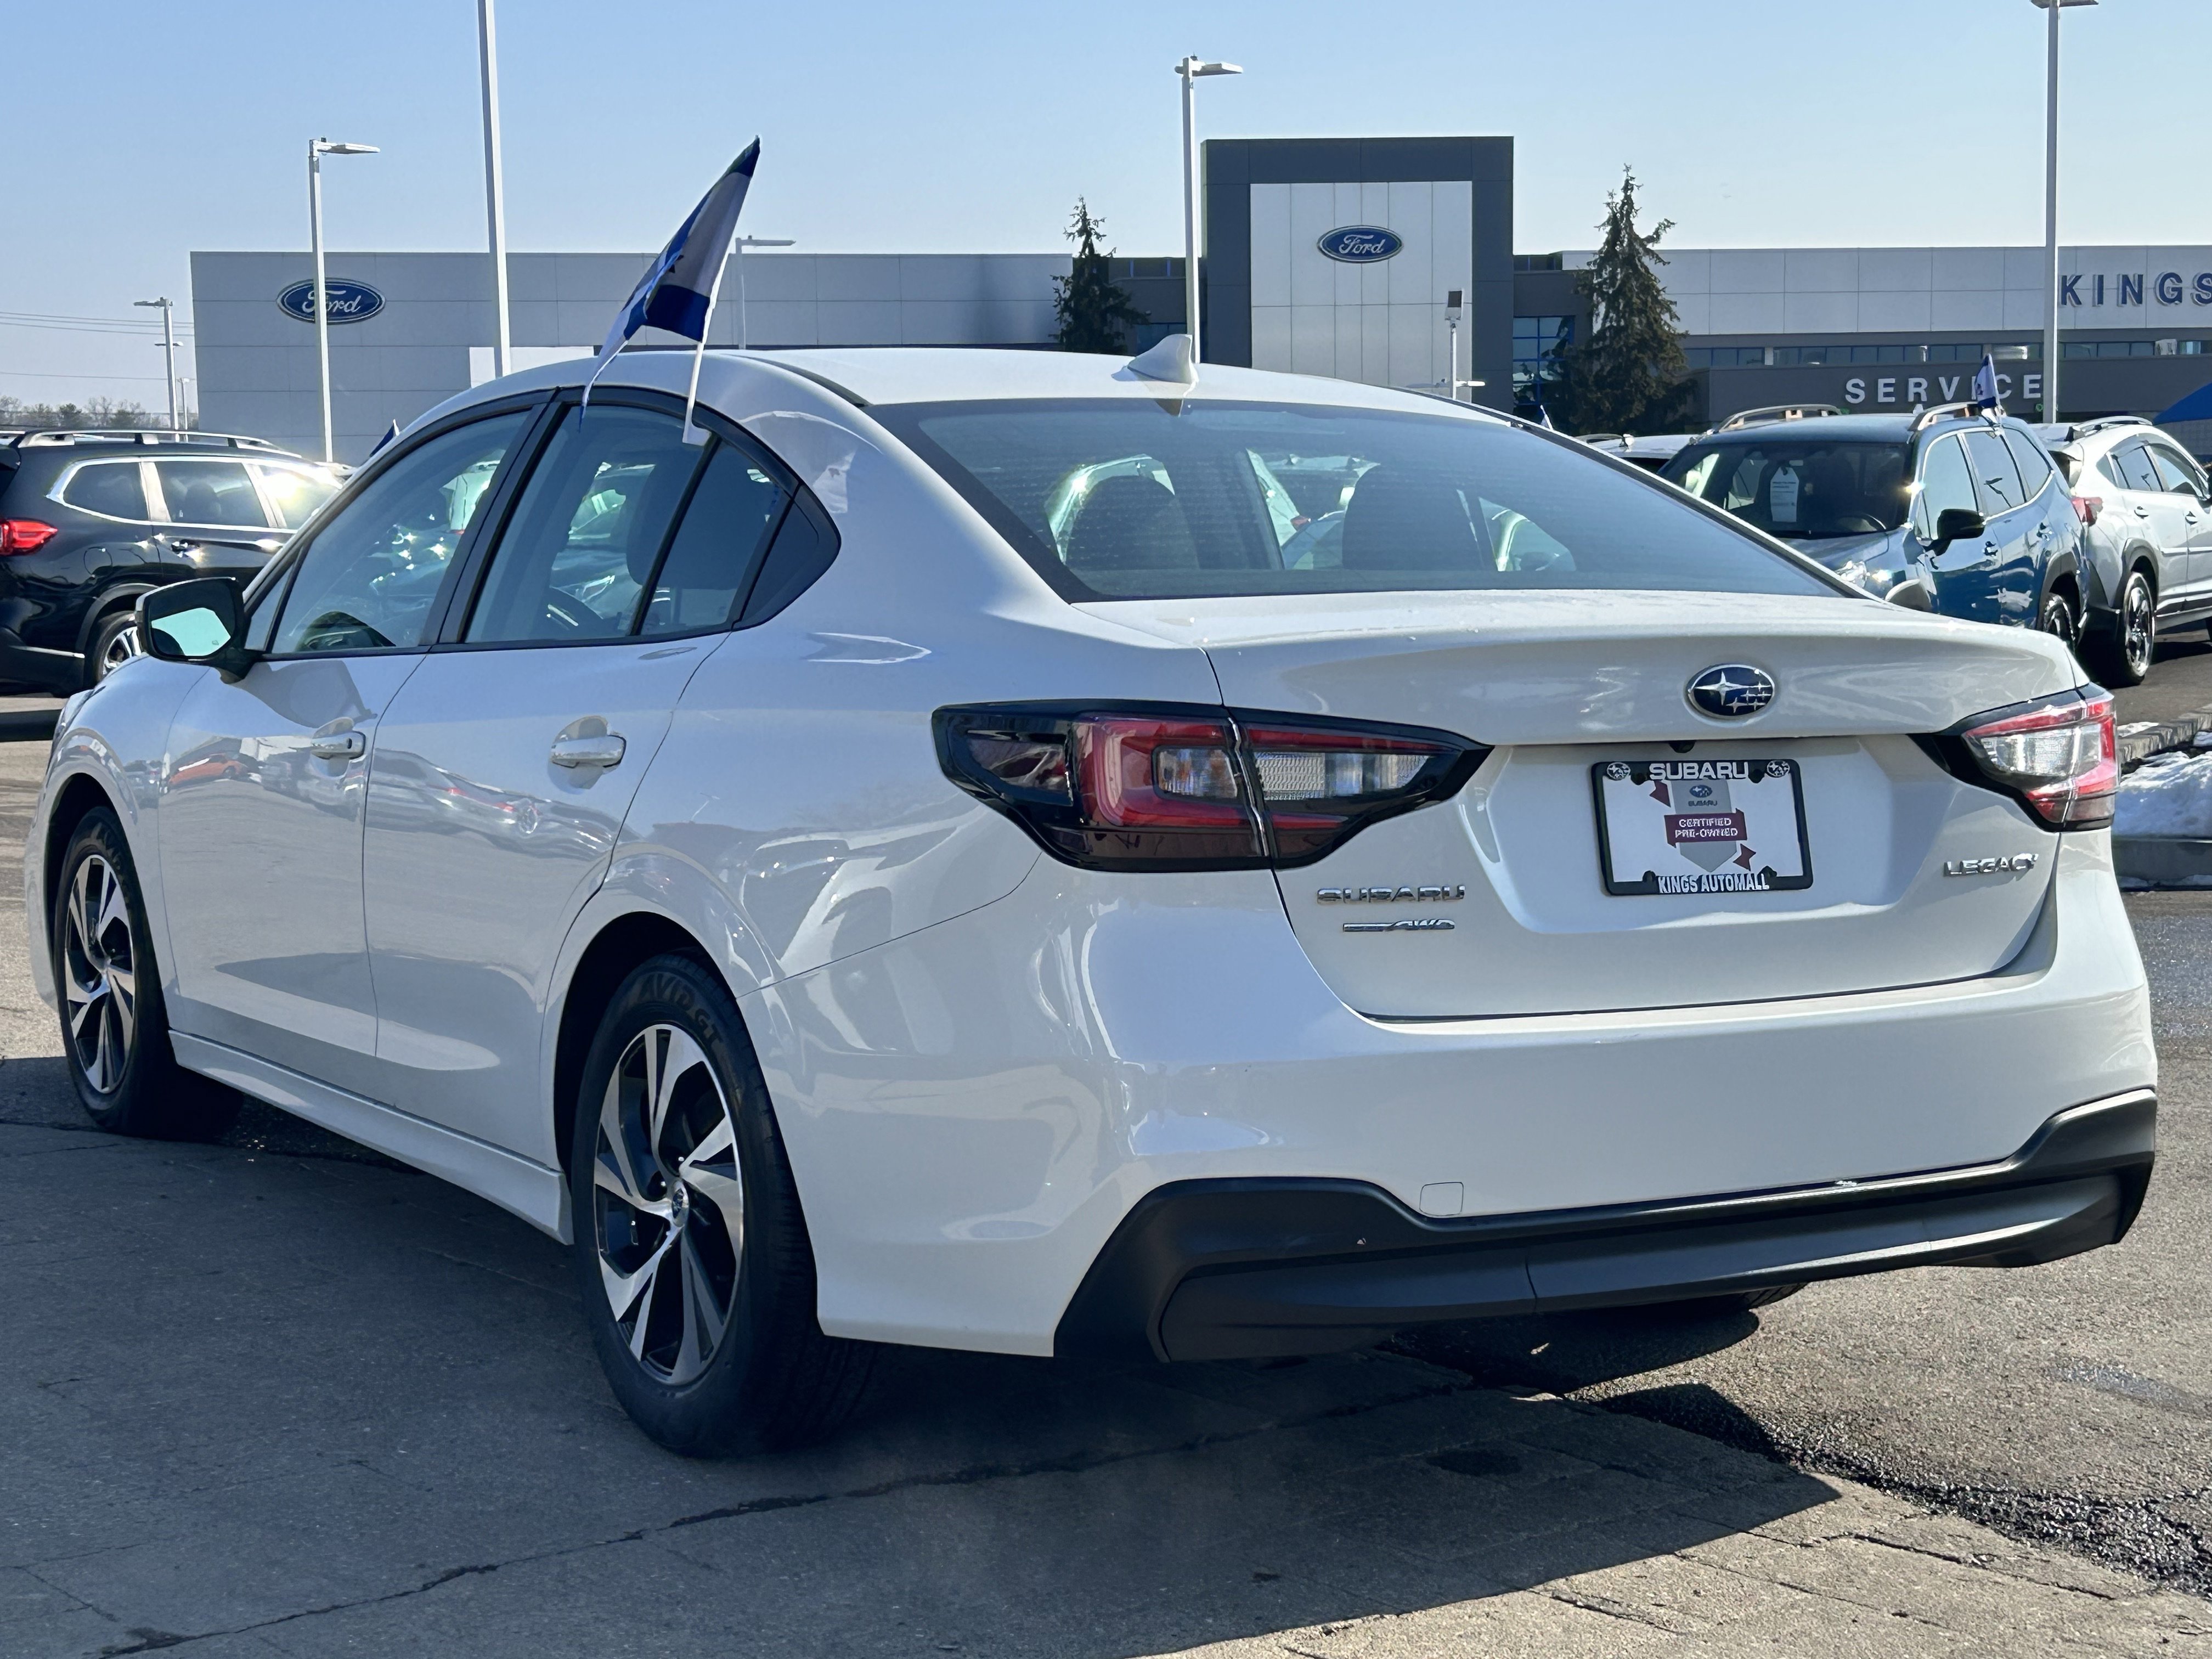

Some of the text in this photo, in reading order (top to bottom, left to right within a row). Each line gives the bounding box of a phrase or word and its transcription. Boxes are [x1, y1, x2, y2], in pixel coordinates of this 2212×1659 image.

[1339, 234, 1386, 254] Ford
[1649, 762, 1748, 780] SUBARU
[1679, 817, 1731, 828] CERTIFIED
[1675, 828, 1738, 838] PRE-OWNED
[1658, 873, 1769, 893] KINGS AUTOMALL
[1317, 884, 1465, 903] SUBARU
